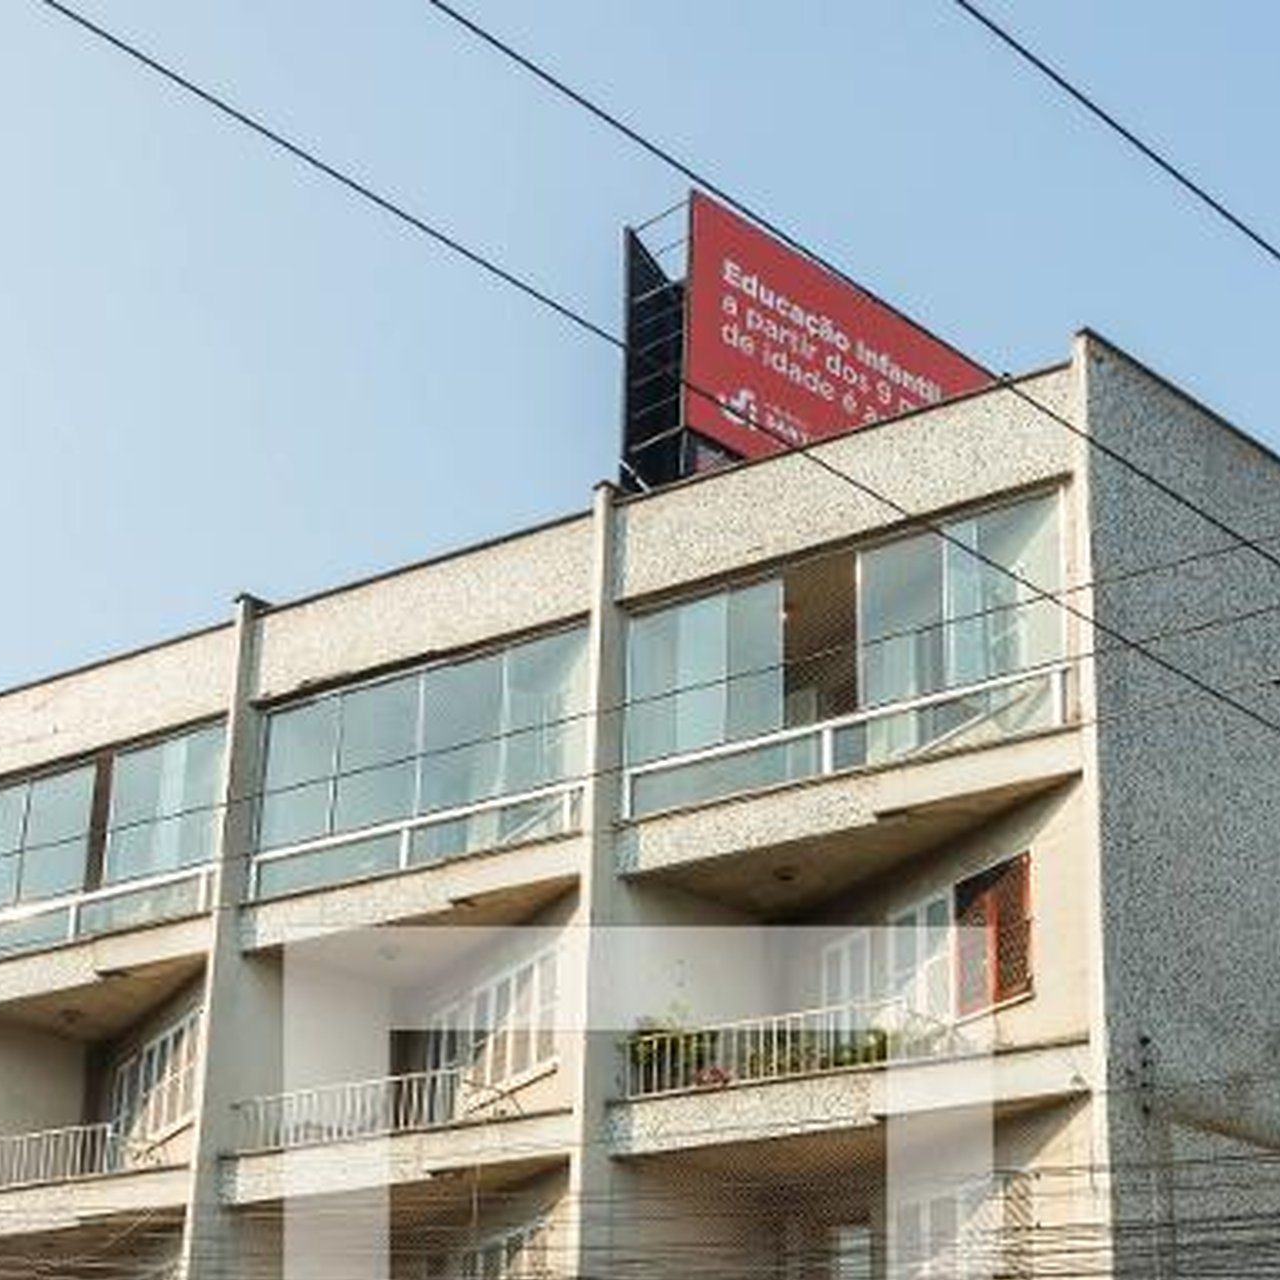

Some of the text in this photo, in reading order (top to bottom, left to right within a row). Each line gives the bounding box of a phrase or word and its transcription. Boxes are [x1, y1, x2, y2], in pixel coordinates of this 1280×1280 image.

[721, 294, 893, 405] a partir dos 9
[722, 259, 851, 353] Educação
[721, 321, 754, 354] de
[762, 340, 836, 400] idade
